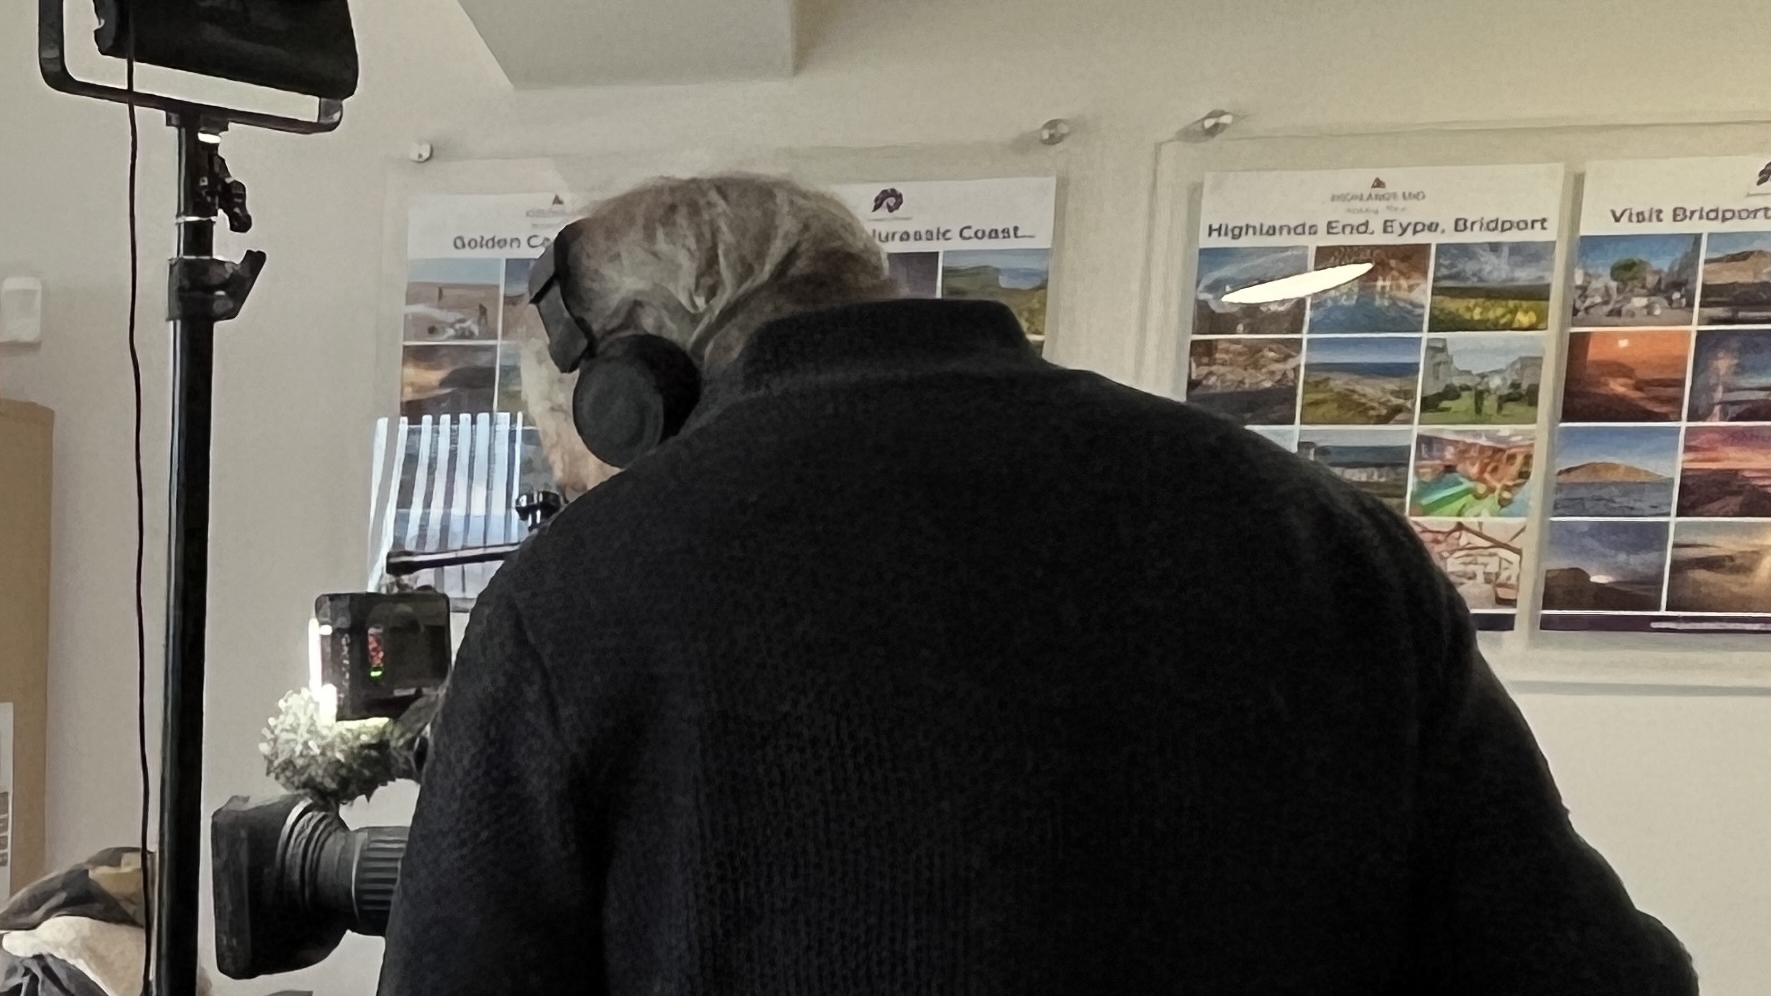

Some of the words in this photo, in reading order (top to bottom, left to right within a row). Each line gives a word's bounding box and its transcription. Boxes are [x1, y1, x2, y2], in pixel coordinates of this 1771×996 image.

[1610, 207, 1664, 223] Visit
[1672, 206, 1771, 223] Bridport
[1207, 222, 1318, 240] Highlands
[1382, 219, 1445, 237] Eype,
[1454, 217, 1548, 233] Bridport
[453, 235, 521, 250] Golden
